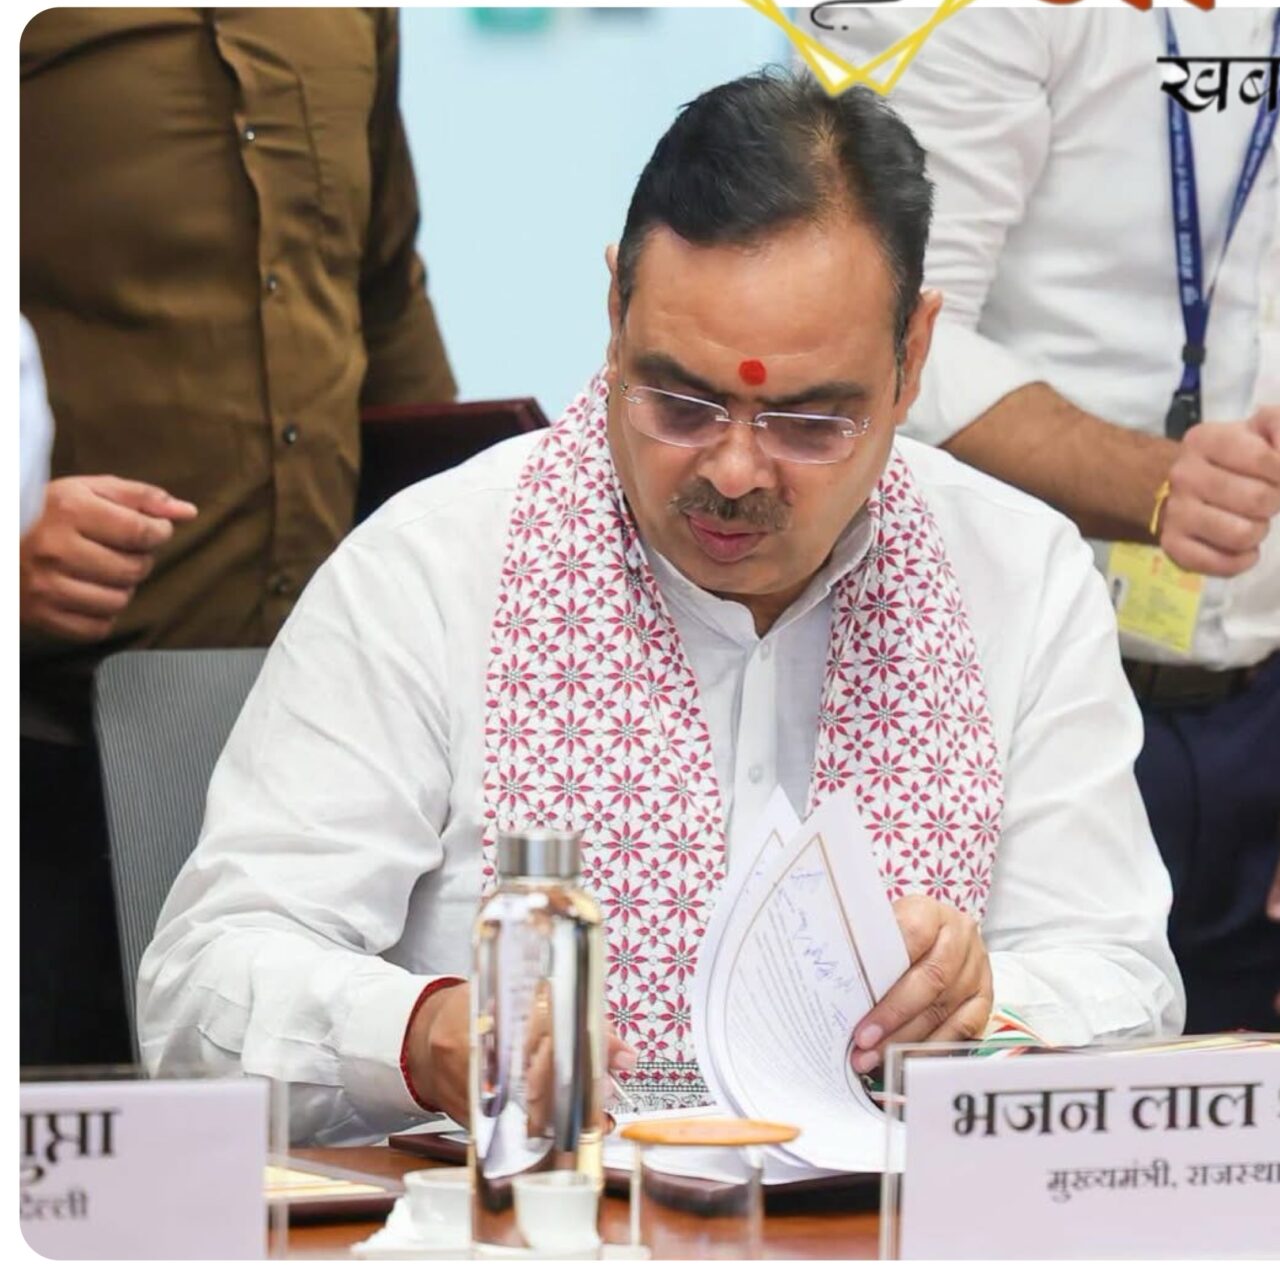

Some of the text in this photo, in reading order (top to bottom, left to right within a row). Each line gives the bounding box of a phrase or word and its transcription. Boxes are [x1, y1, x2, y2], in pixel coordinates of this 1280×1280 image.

[952, 1087, 1114, 1138] भजन
[1129, 1080, 1264, 1133] लाल
[1046, 1157, 1178, 1204] मुख्यमंत्री,
